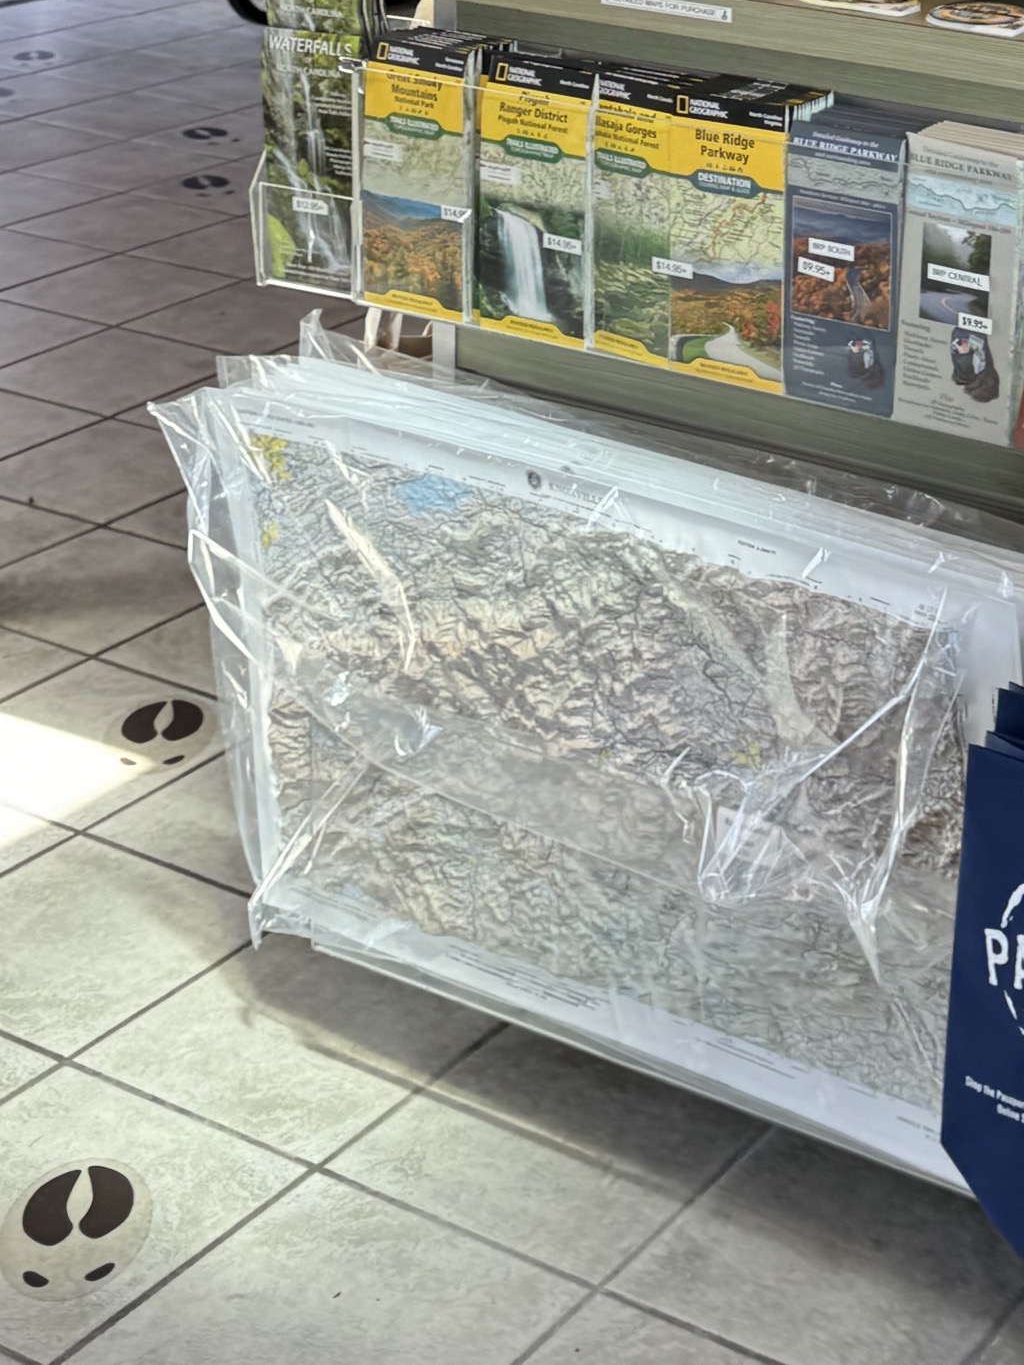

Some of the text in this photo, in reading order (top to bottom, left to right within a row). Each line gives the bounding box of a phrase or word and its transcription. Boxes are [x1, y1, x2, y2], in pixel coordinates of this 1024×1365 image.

[665, 1, 679, 10] FOR
[681, 3, 716, 16] PURCHASE
[269, 34, 353, 57] WATERFALLS
[389, 45, 415, 57] NATIONAL
[387, 51, 420, 65] GEOGRAPHIC
[507, 65, 536, 77] NATIONAL
[386, 69, 443, 91] Great Smoky
[391, 84, 438, 101] Mountains
[499, 102, 568, 123] Ranger District
[689, 99, 720, 111] NATIONAL
[689, 105, 728, 119] GEOGRAPHIC
[626, 123, 657, 139] Gorges
[694, 128, 755, 149] Blue Ridge
[700, 145, 749, 165] Parkway
[793, 137, 899, 162] BLUE RIDGE PARKWAY
[910, 152, 1013, 181] BLUE RIDGE PARKWAY
[697, 171, 752, 189] DESTINATION
[812, 242, 851, 255] BRP SOUTH
[655, 259, 688, 274] $14.95+
[802, 261, 831, 277] $9.95+
[948, 271, 984, 287] CENTRAL
[962, 316, 989, 330] $9.95+
